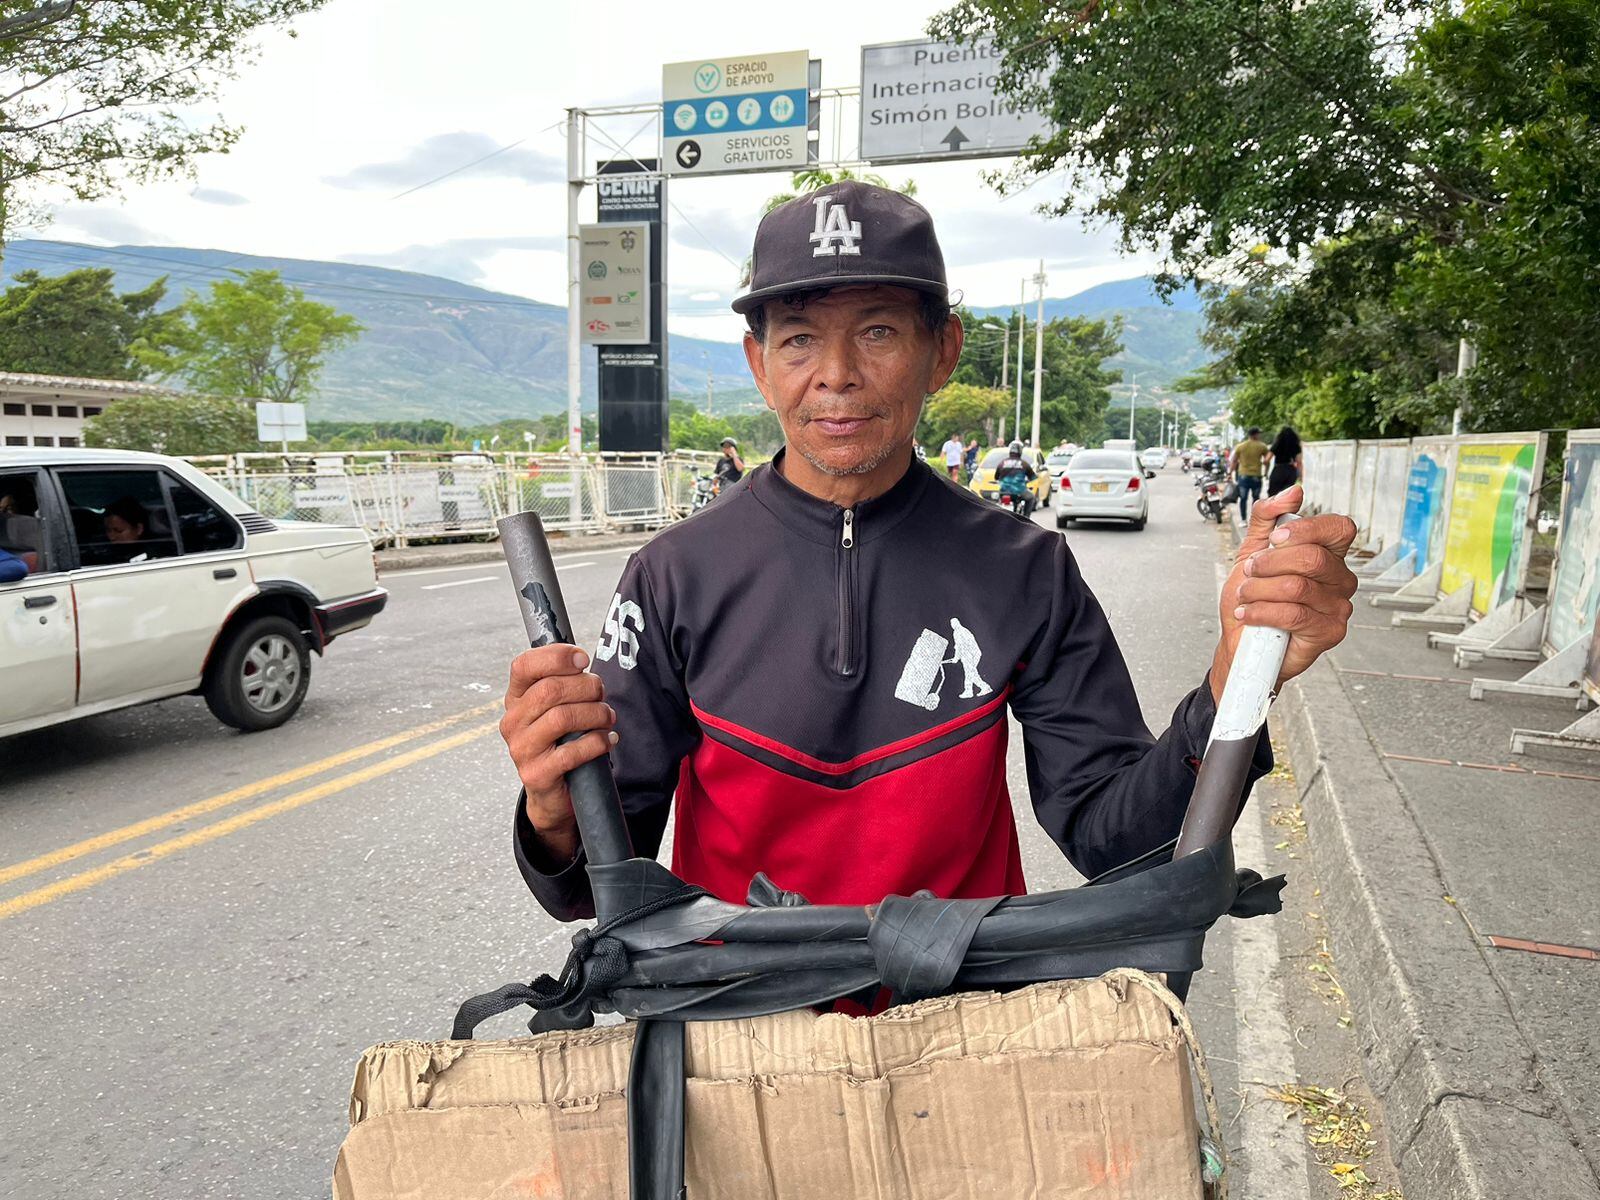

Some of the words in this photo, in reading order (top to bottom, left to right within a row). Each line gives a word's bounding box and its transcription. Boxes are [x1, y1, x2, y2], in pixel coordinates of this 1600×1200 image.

[913, 43, 1002, 66] Puente
[726, 61, 767, 76] ESPACIO
[726, 76, 739, 87] DE
[741, 73, 775, 86] APOYO
[870, 103, 947, 125] Simón
[726, 135, 790, 150] SERVICIOS
[724, 148, 793, 164] GRATUITOS
[809, 195, 862, 258] LA
